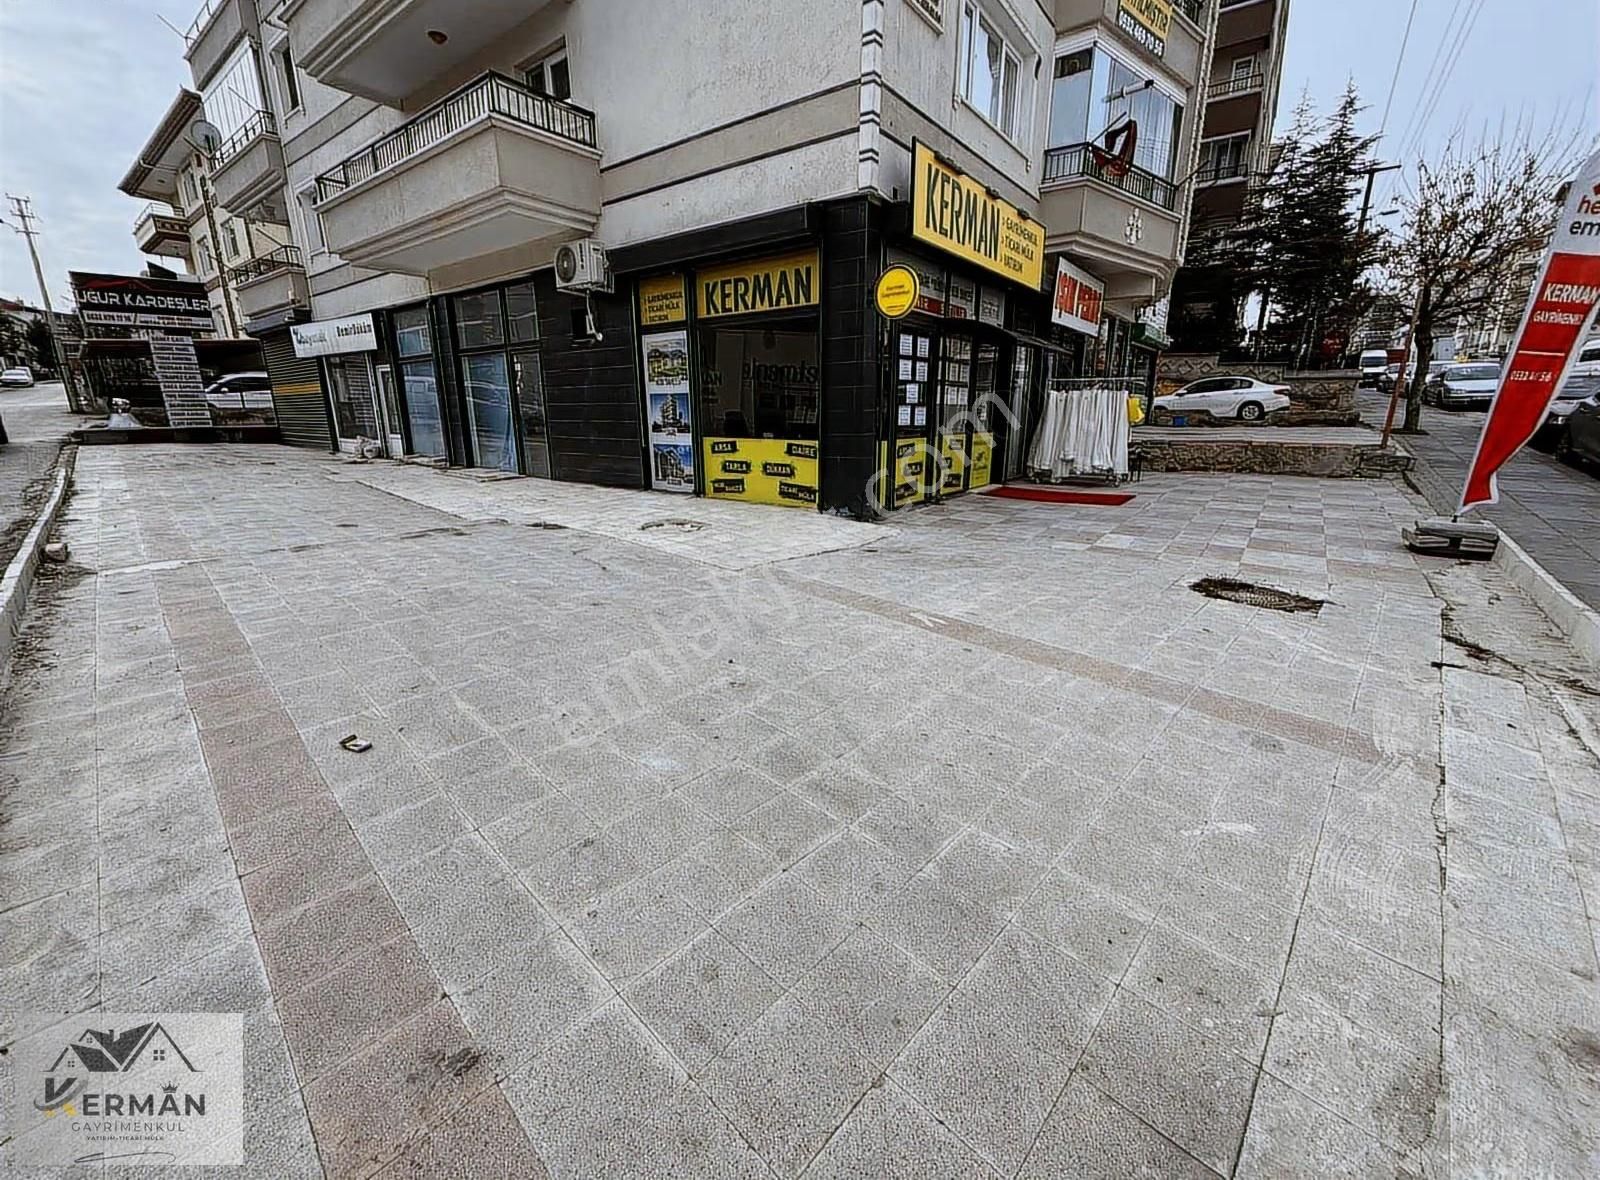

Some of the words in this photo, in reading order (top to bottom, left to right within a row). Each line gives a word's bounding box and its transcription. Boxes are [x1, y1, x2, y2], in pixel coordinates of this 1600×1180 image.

[925, 163, 1001, 262] KERMAN
[123, 293, 211, 313] KARDEŞLER
[704, 266, 812, 316] KERMAN
[1542, 282, 1600, 305] KERMAN
